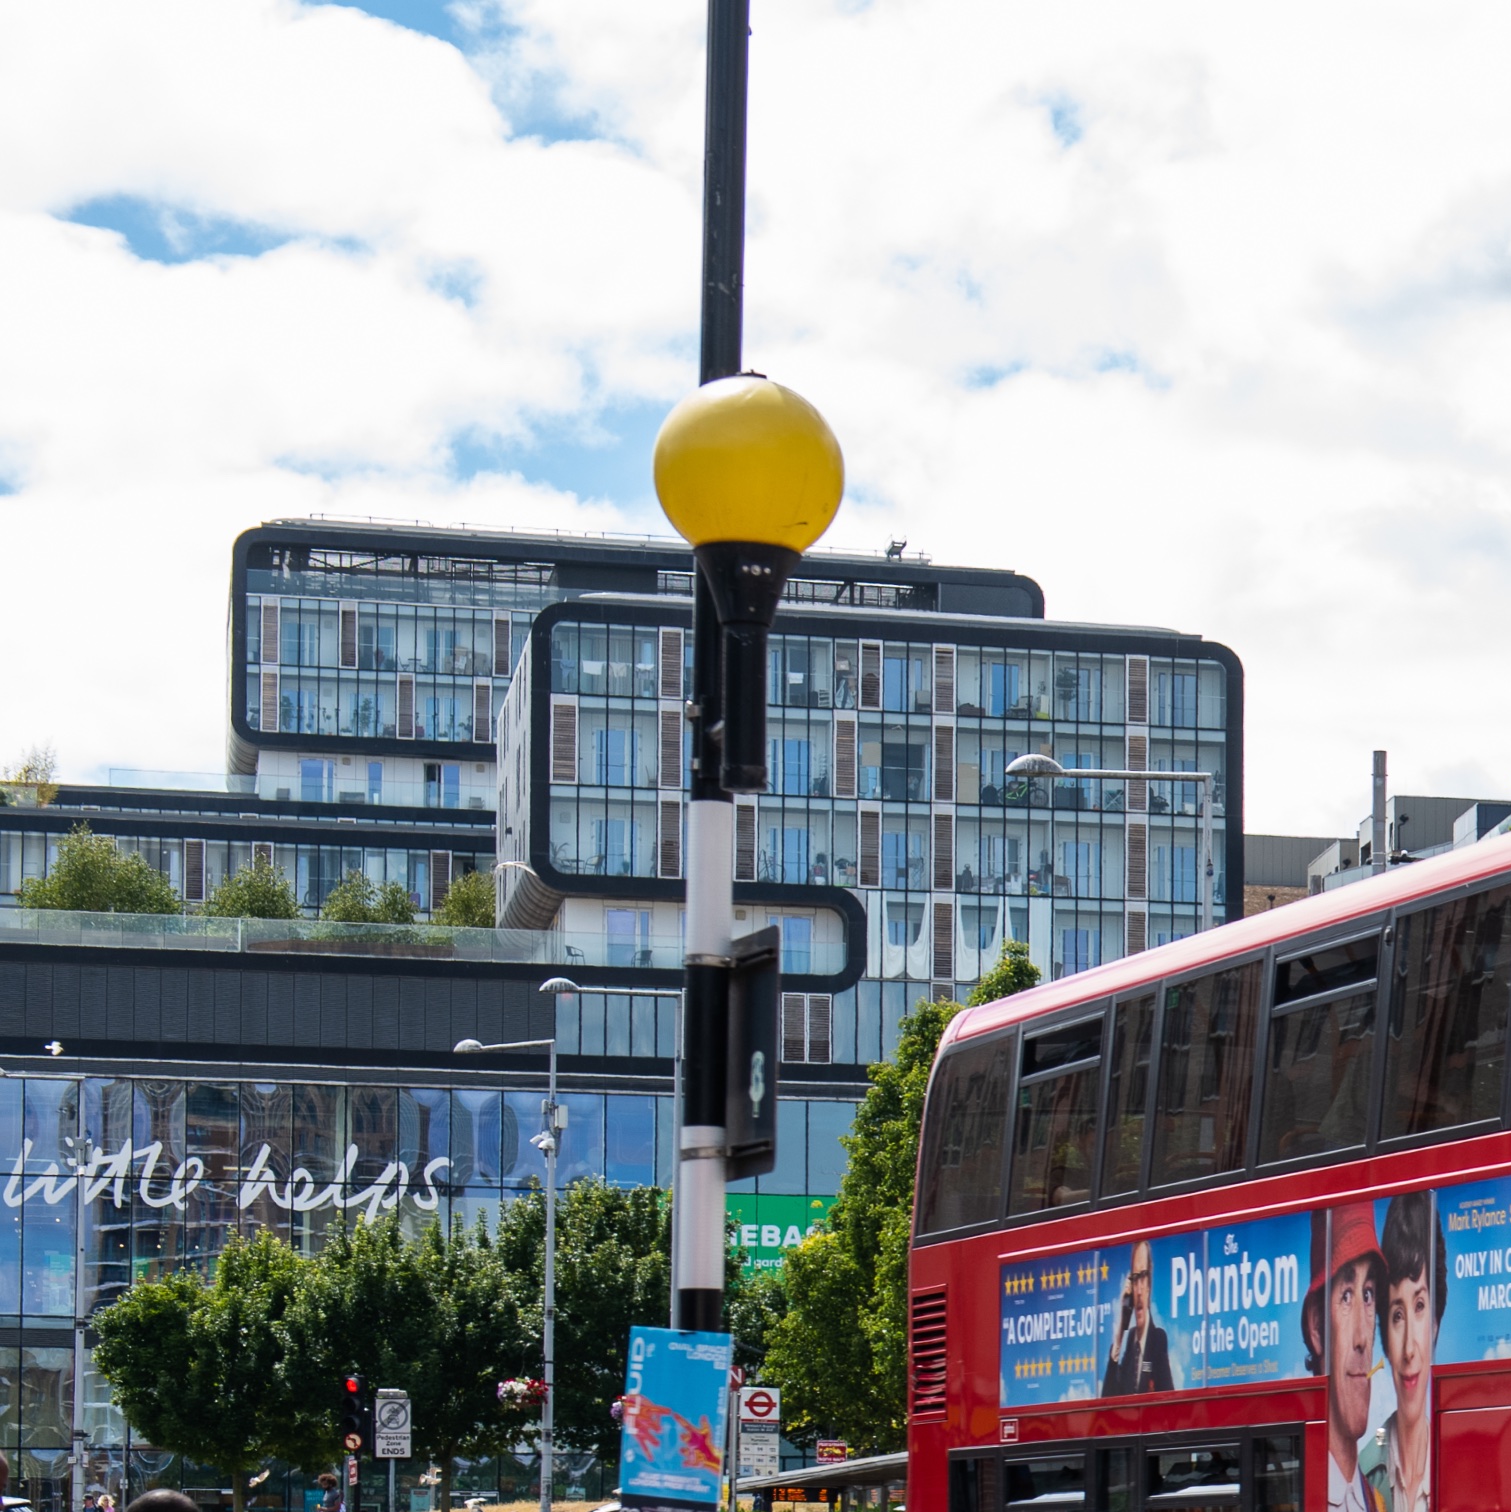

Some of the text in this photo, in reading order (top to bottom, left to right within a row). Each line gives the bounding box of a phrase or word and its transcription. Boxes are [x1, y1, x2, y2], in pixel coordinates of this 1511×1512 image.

[235, 1142, 454, 1224] helps
[1448, 1208, 1507, 1233] Mark Rylance
[1455, 1252, 1487, 1279] ONLY
[1489, 1249, 1503, 1275] IN
[1171, 1250, 1299, 1319] Phantom
[1017, 1308, 1076, 1344] COMPLETE
[1192, 1315, 1279, 1358] of the Open
[625, 1336, 645, 1435] FLUID
[381, 1447, 406, 1456] ENDS
